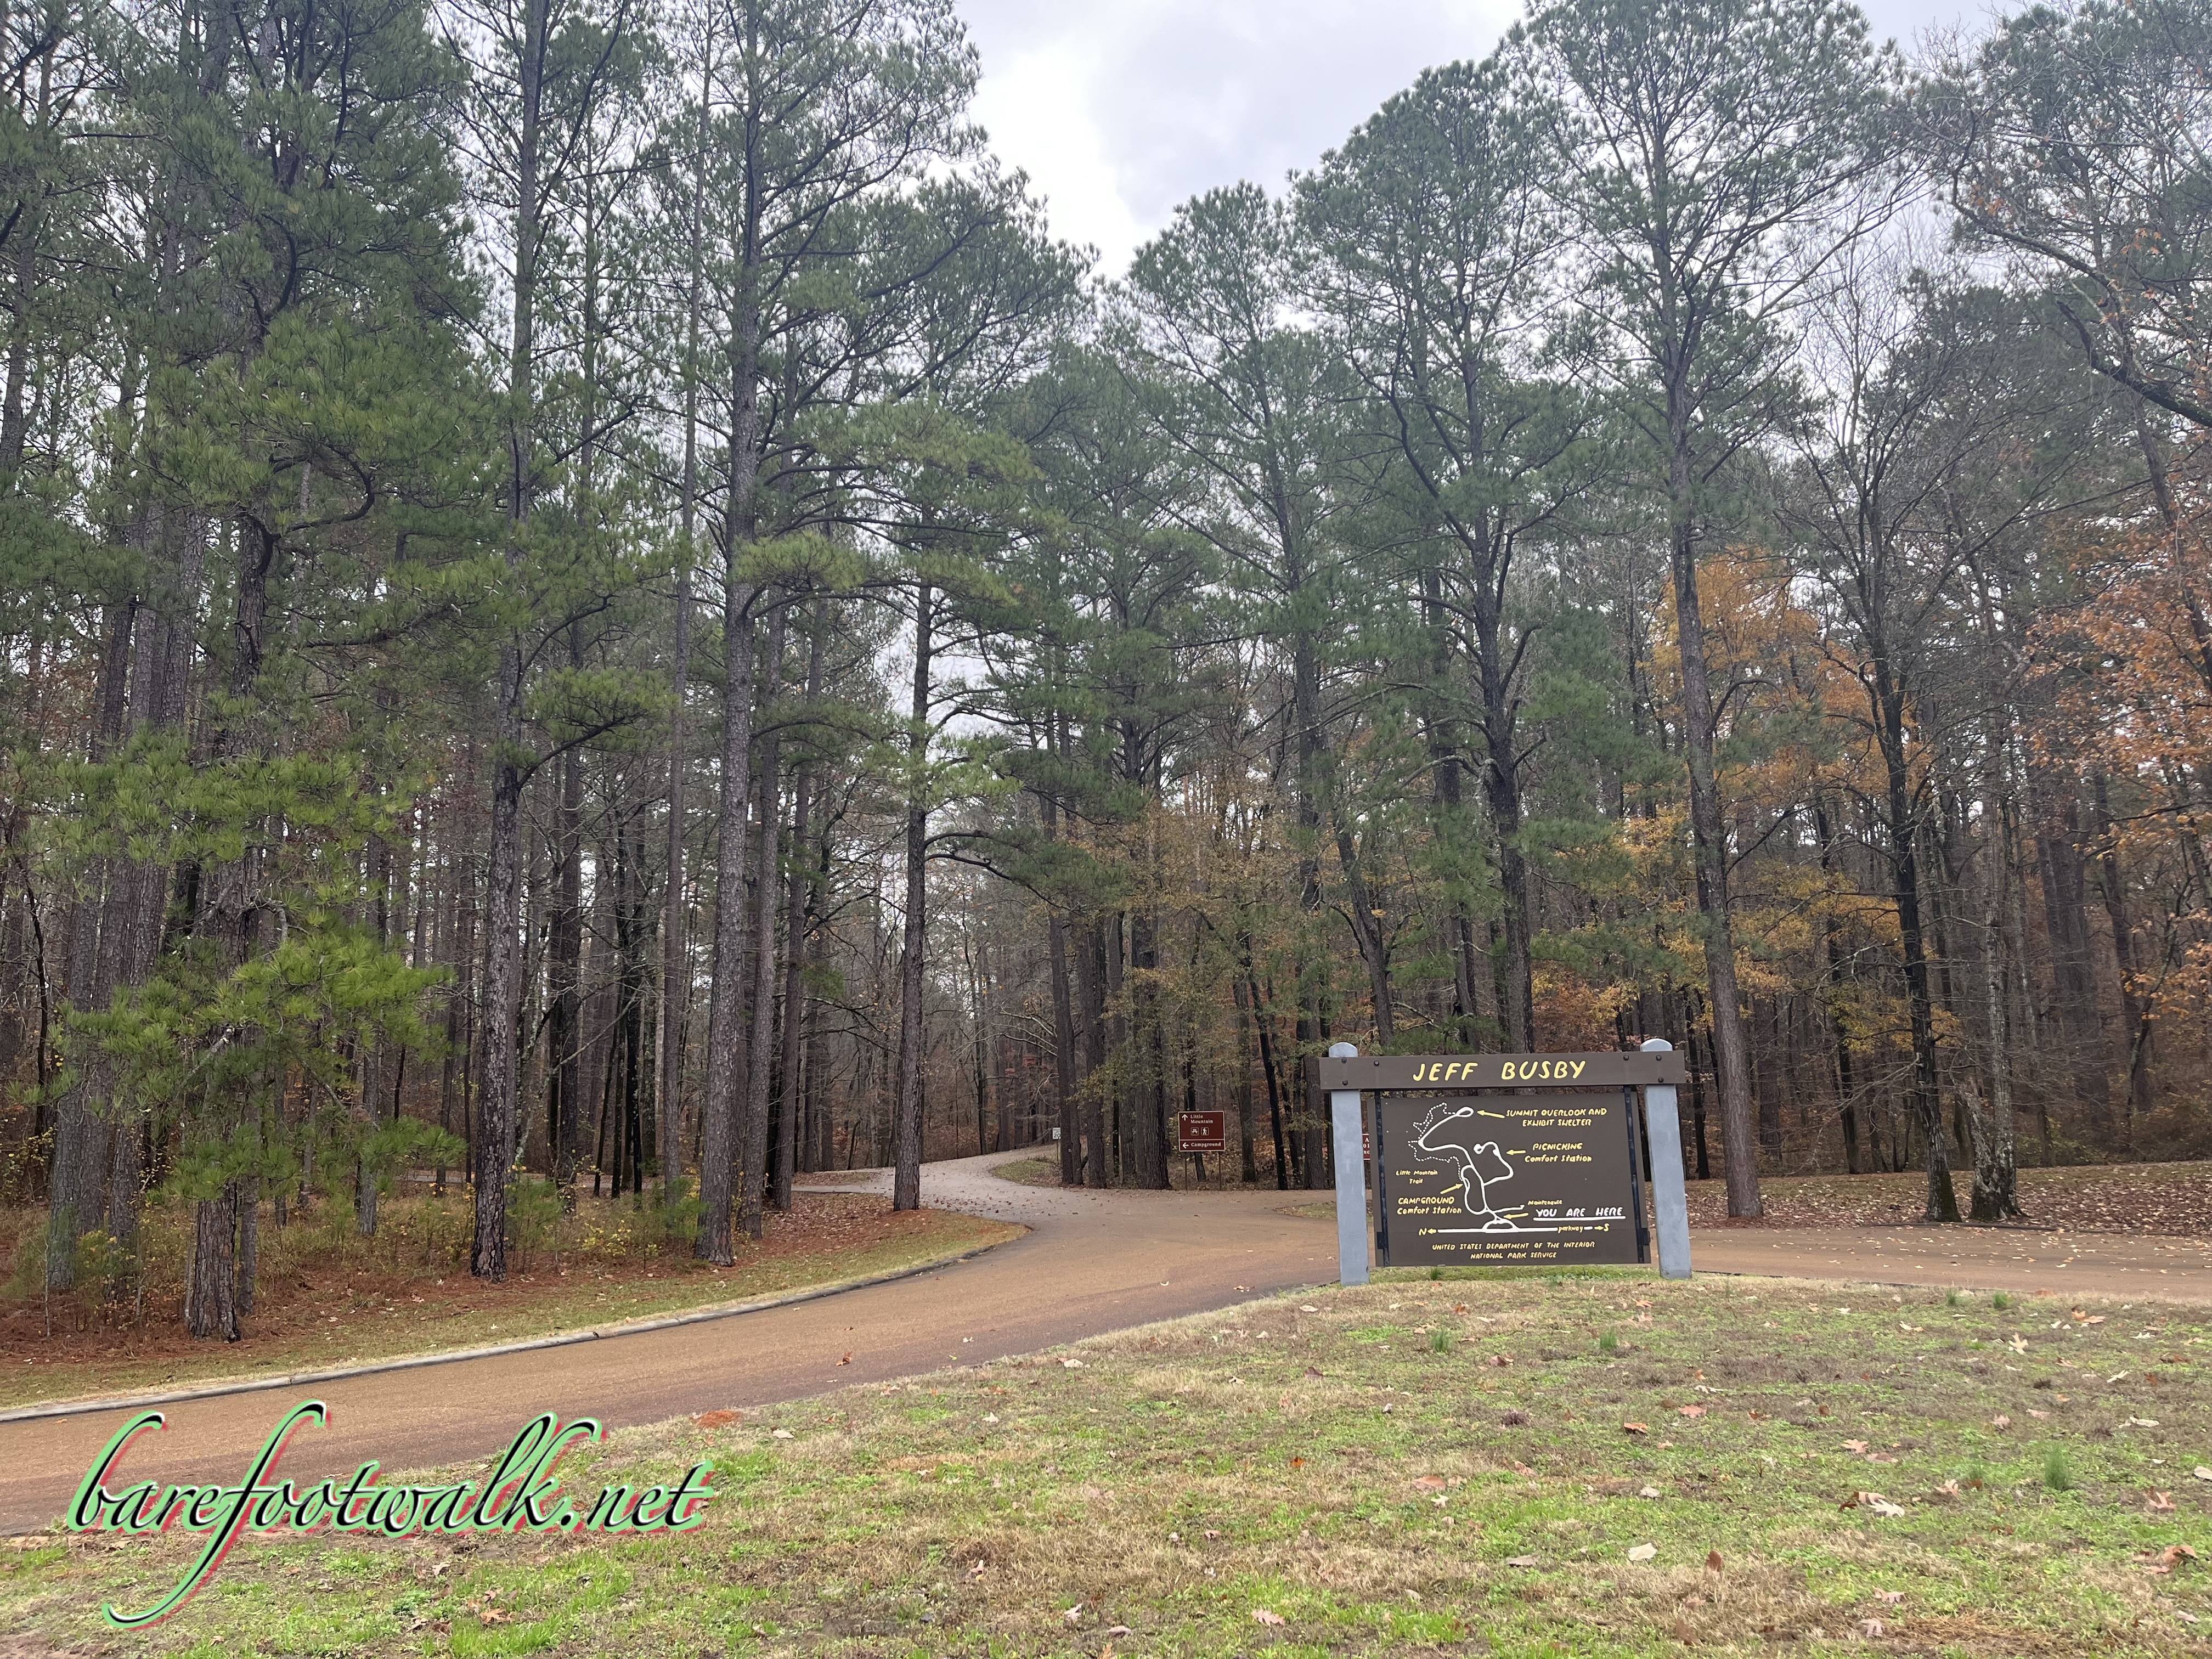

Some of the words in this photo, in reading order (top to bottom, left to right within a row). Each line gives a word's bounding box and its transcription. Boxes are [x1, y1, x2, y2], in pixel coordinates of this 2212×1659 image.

[1413, 1062, 1479, 1081] JEFF
[1501, 1060, 1586, 1080] BUSBY
[1541, 1108, 1587, 1117] OVERLOOK
[1522, 1119, 1555, 1127] EXHIBIT
[1557, 1118, 1592, 1127] SHELTER
[1532, 1142, 1583, 1151] PICNICKING
[1524, 1154, 1559, 1163] Comfort
[1561, 1153, 1592, 1163] Station
[1398, 1196, 1455, 1205] CAMPGROUND
[1397, 1205, 1430, 1215] Comfort
[1432, 1205, 1462, 1214] Station
[1535, 1208, 1558, 1217] YOU
[1566, 1207, 1586, 1217] ARE
[1595, 1206, 1623, 1216] HERE
[1418, 1227, 1427, 1236] N
[1557, 1225, 1583, 1234] parkway
[1602, 1223, 1610, 1232] S
